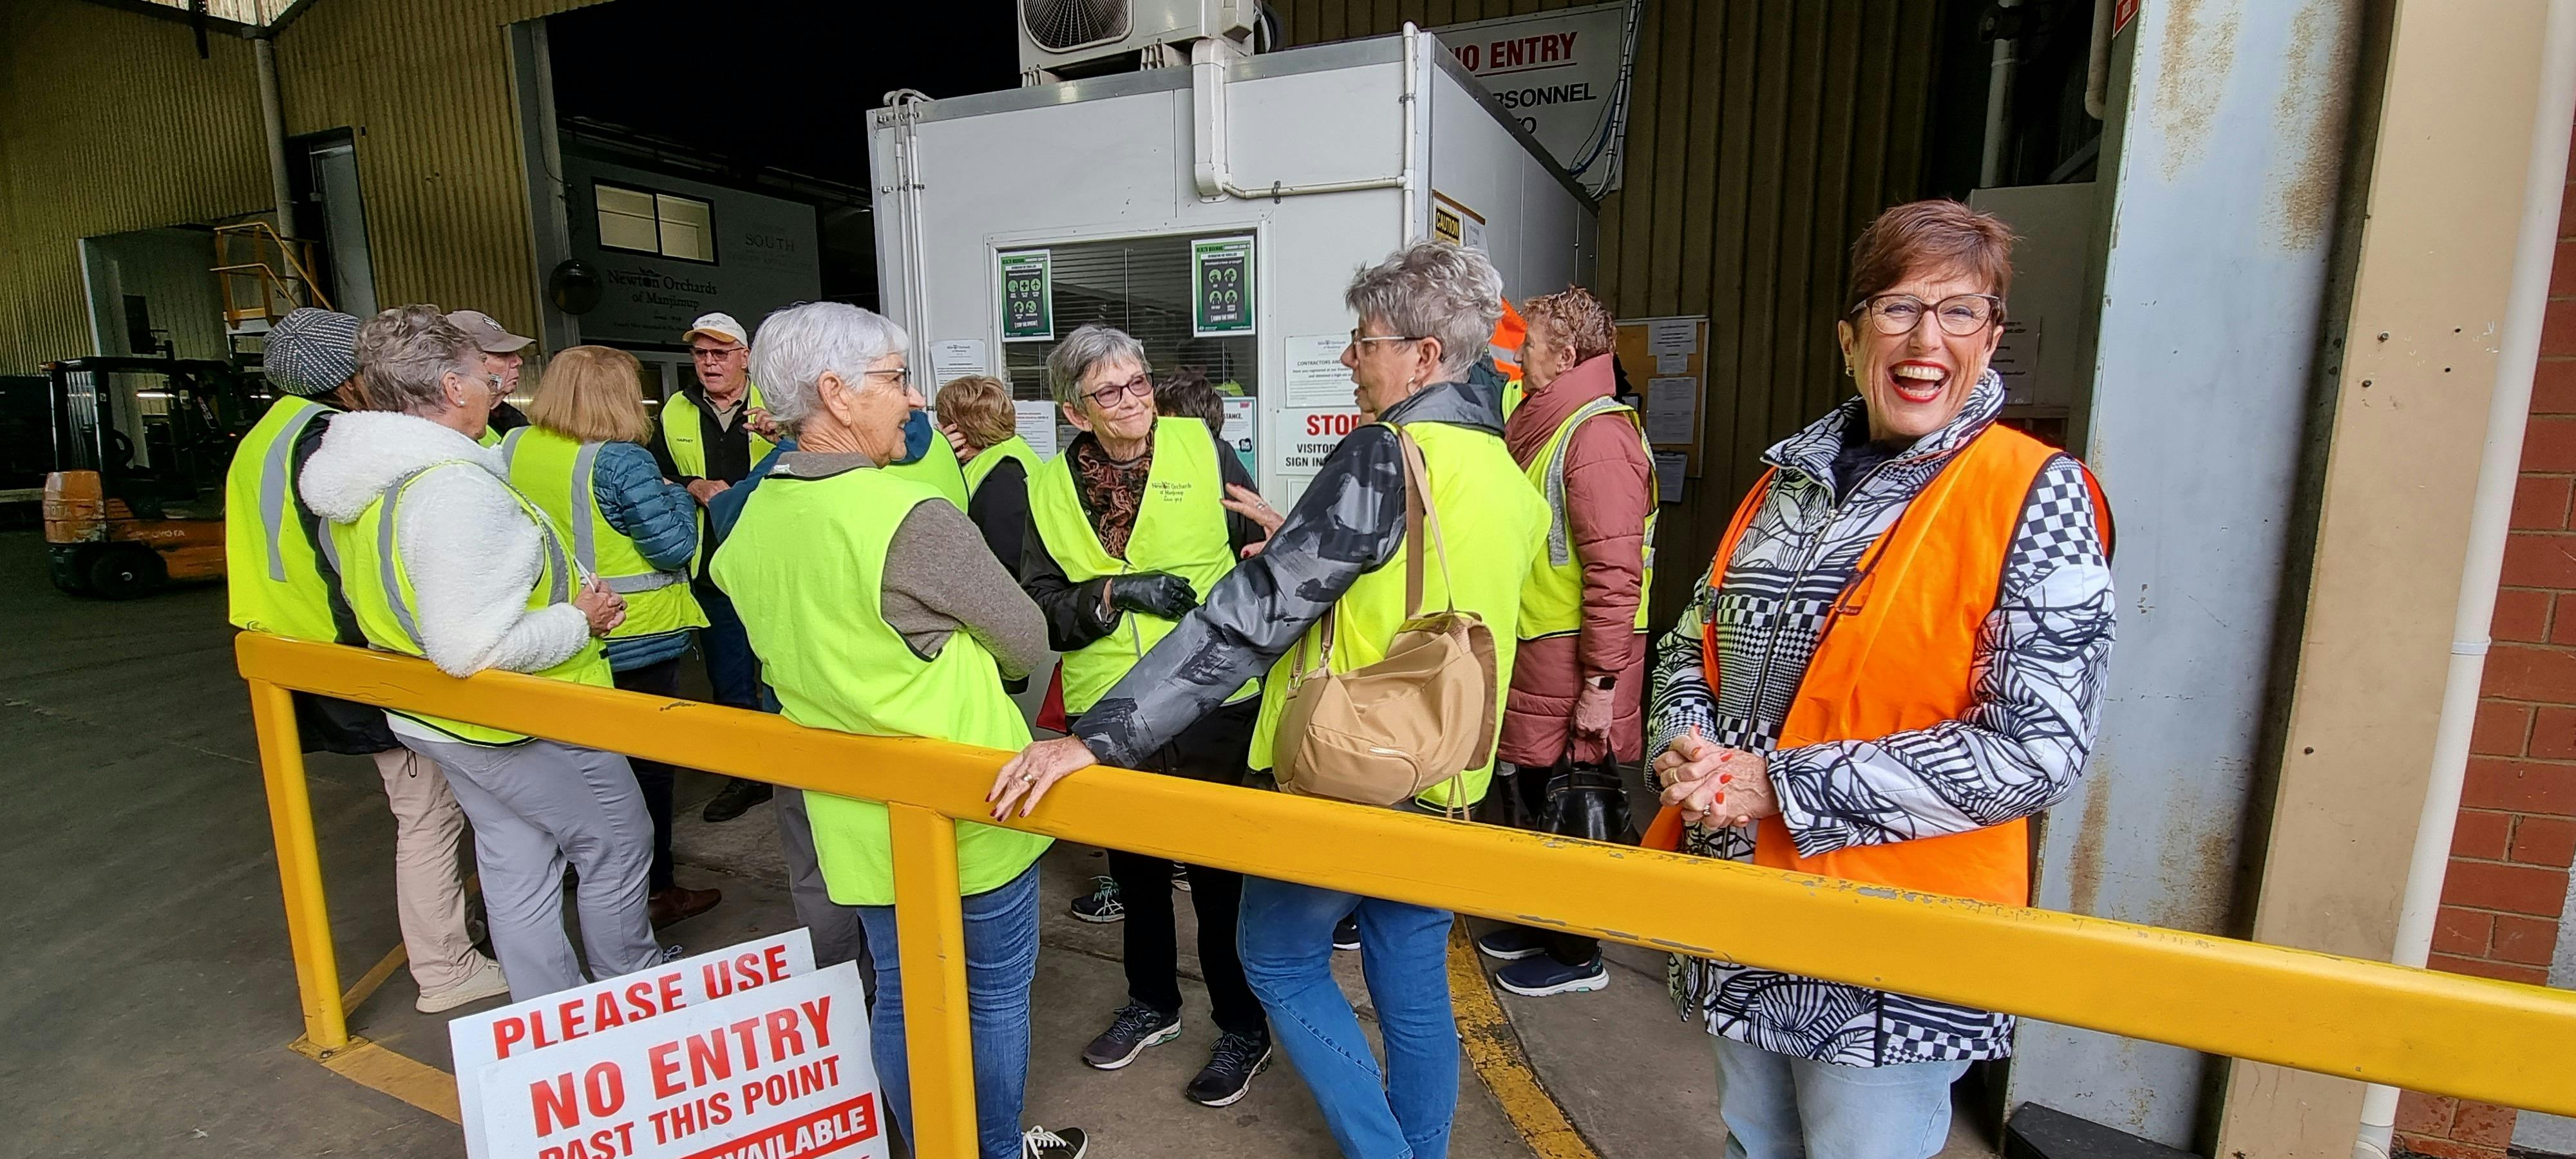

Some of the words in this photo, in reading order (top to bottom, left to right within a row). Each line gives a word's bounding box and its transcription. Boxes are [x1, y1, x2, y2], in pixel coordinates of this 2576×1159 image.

[1490, 32, 1578, 69] ENTRY
[1492, 82, 1597, 109] RSONNEL
[1516, 116, 1537, 135] O
[1437, 211, 1459, 237] CAUTION
[745, 232, 795, 252] SOUTH
[607, 269, 659, 288] Newton
[663, 276, 717, 294] Orchards
[632, 292, 643, 302] of
[647, 291, 699, 311] Manjimup
[1285, 457, 1309, 466] SIGN
[146, 529, 185, 538] OYOTA
[492, 972, 687, 1060] PLEASE
[703, 945, 791, 1000] USE
[529, 1061, 625, 1138] NO
[648, 996, 831, 1100] ENTRY
[648, 1092, 733, 1146] THIS
[741, 1059, 839, 1116] POINT
[712, 1106, 867, 1159] AILABLE
